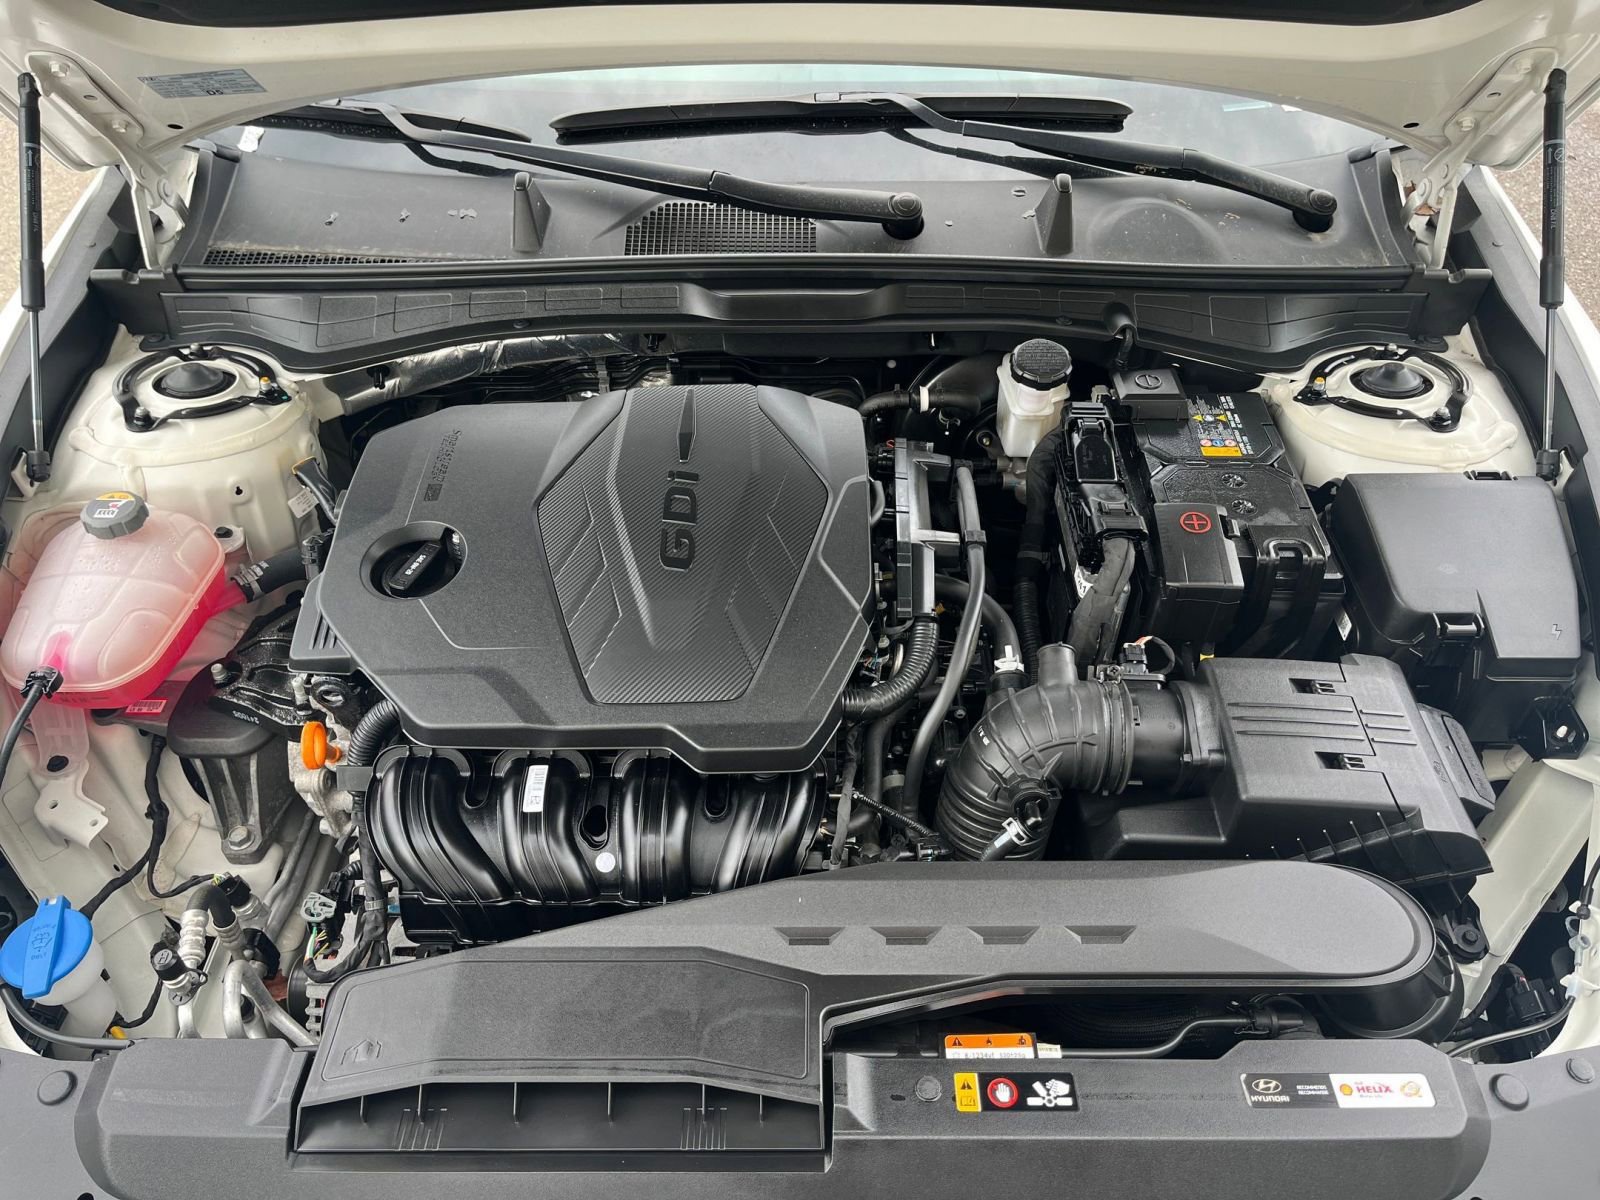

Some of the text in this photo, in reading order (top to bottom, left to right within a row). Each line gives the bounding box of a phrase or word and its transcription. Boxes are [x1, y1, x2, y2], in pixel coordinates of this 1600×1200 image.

[438, 429, 461, 483] Smartstream
[659, 470, 699, 572] GDi
[158, 952, 170, 963] H
[1356, 1085, 1392, 1093] HELIX
[1250, 1095, 1290, 1103] HYUNDAI
